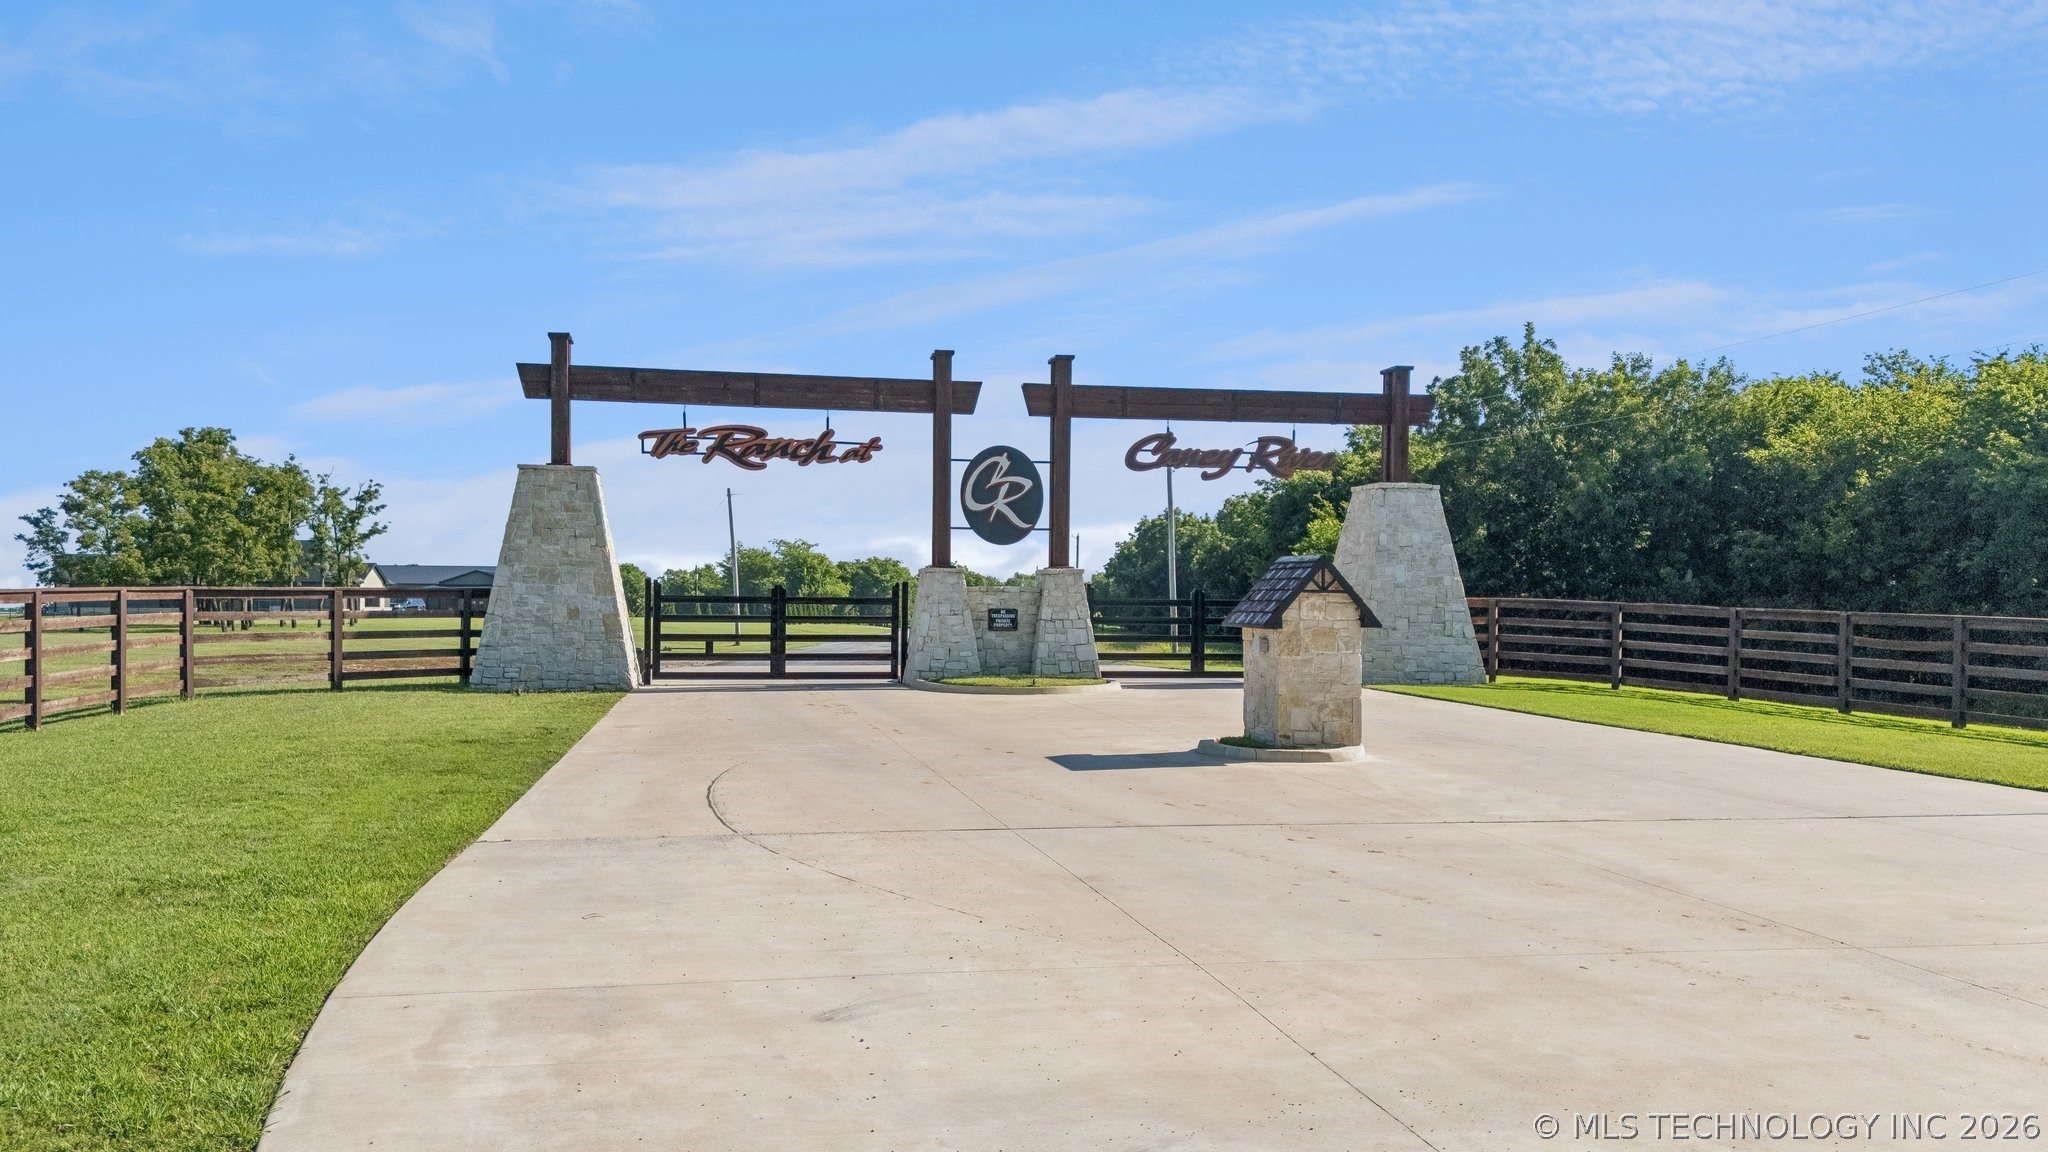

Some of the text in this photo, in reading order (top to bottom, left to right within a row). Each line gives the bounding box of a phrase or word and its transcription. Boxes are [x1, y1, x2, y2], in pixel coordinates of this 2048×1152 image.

[638, 425, 883, 471] The Ranch at
